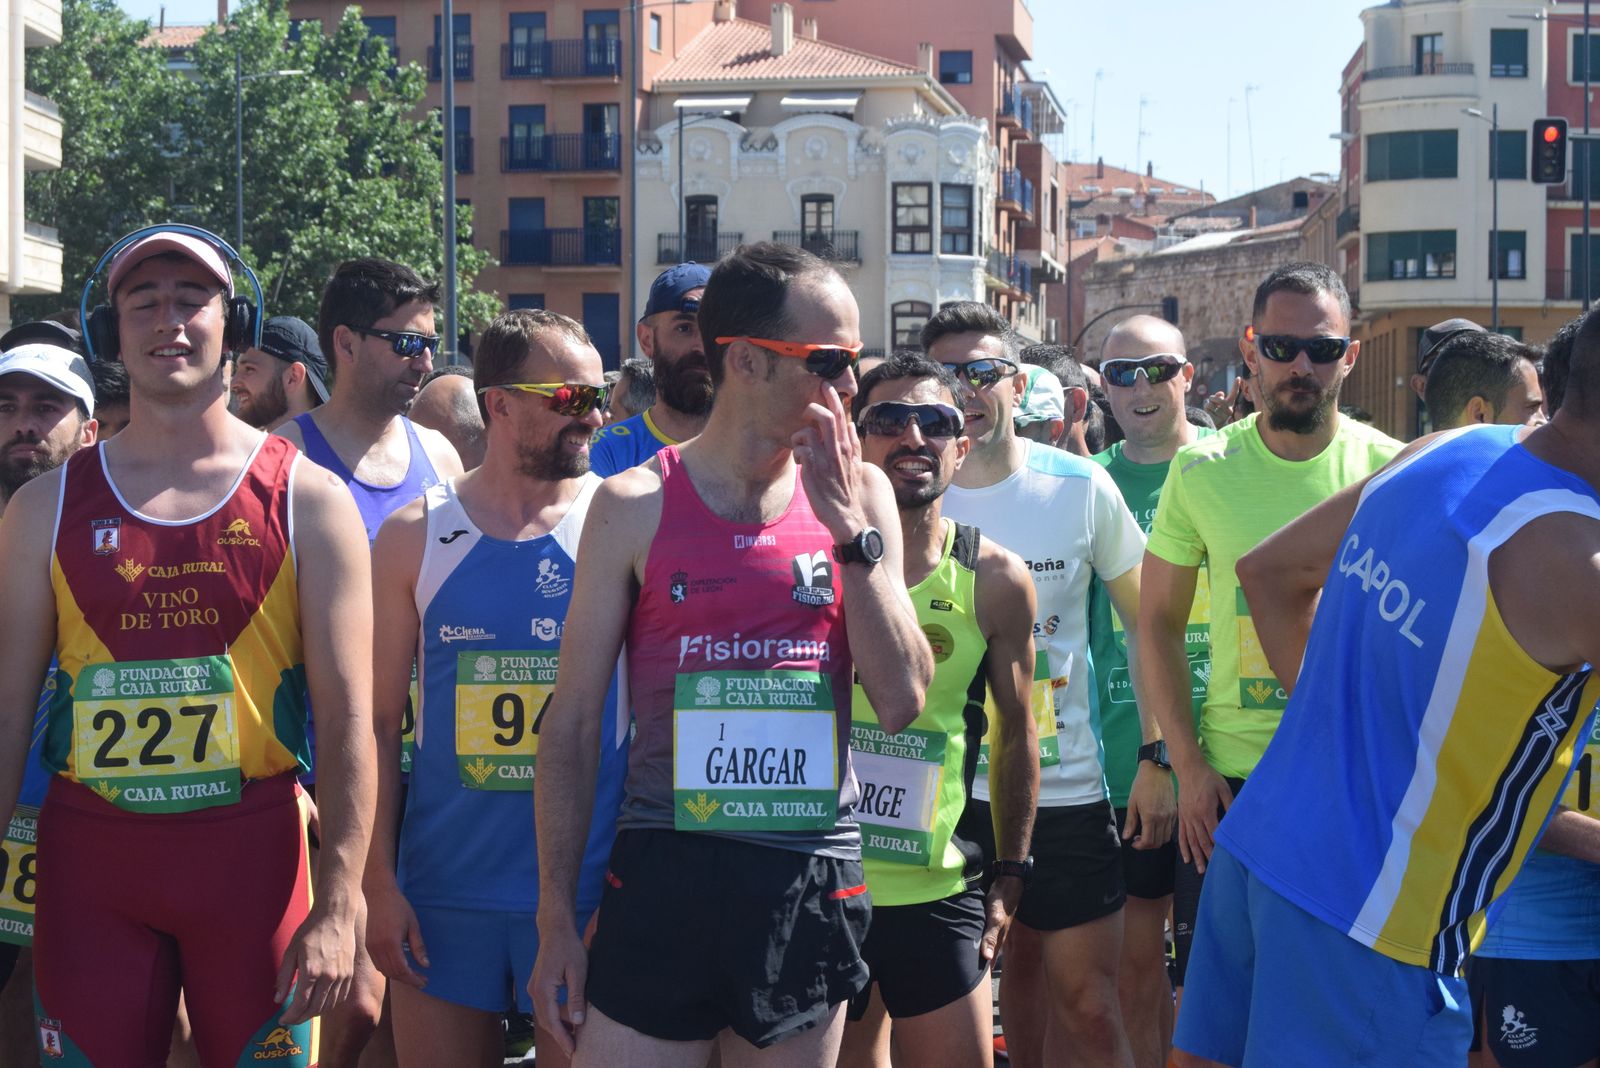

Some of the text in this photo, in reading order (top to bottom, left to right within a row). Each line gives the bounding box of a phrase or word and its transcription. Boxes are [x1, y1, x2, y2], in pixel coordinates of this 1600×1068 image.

[216, 536, 261, 547] austral
[147, 561, 226, 578] CAJA RURAL
[142, 587, 199, 609] VINO
[1339, 534, 1426, 648] CAPOL
[120, 608, 220, 630] DE TORO
[678, 632, 830, 669] Fisiorama
[119, 664, 211, 682] FUNDACION
[500, 670, 534, 682] CAJA
[119, 679, 212, 696] CAJA RURAL
[725, 678, 816, 693] FUNDACION
[725, 692, 817, 706] CAJA RURAL
[92, 703, 218, 768] 227
[718, 722, 725, 741] 1
[879, 740, 926, 760] RURAL
[705, 747, 807, 785] GARGAR
[123, 781, 231, 802] CAJA RURAL
[722, 801, 827, 818] CAJA RURAL
[868, 834, 922, 855] RURAL
[254, 1046, 303, 1060] austral
